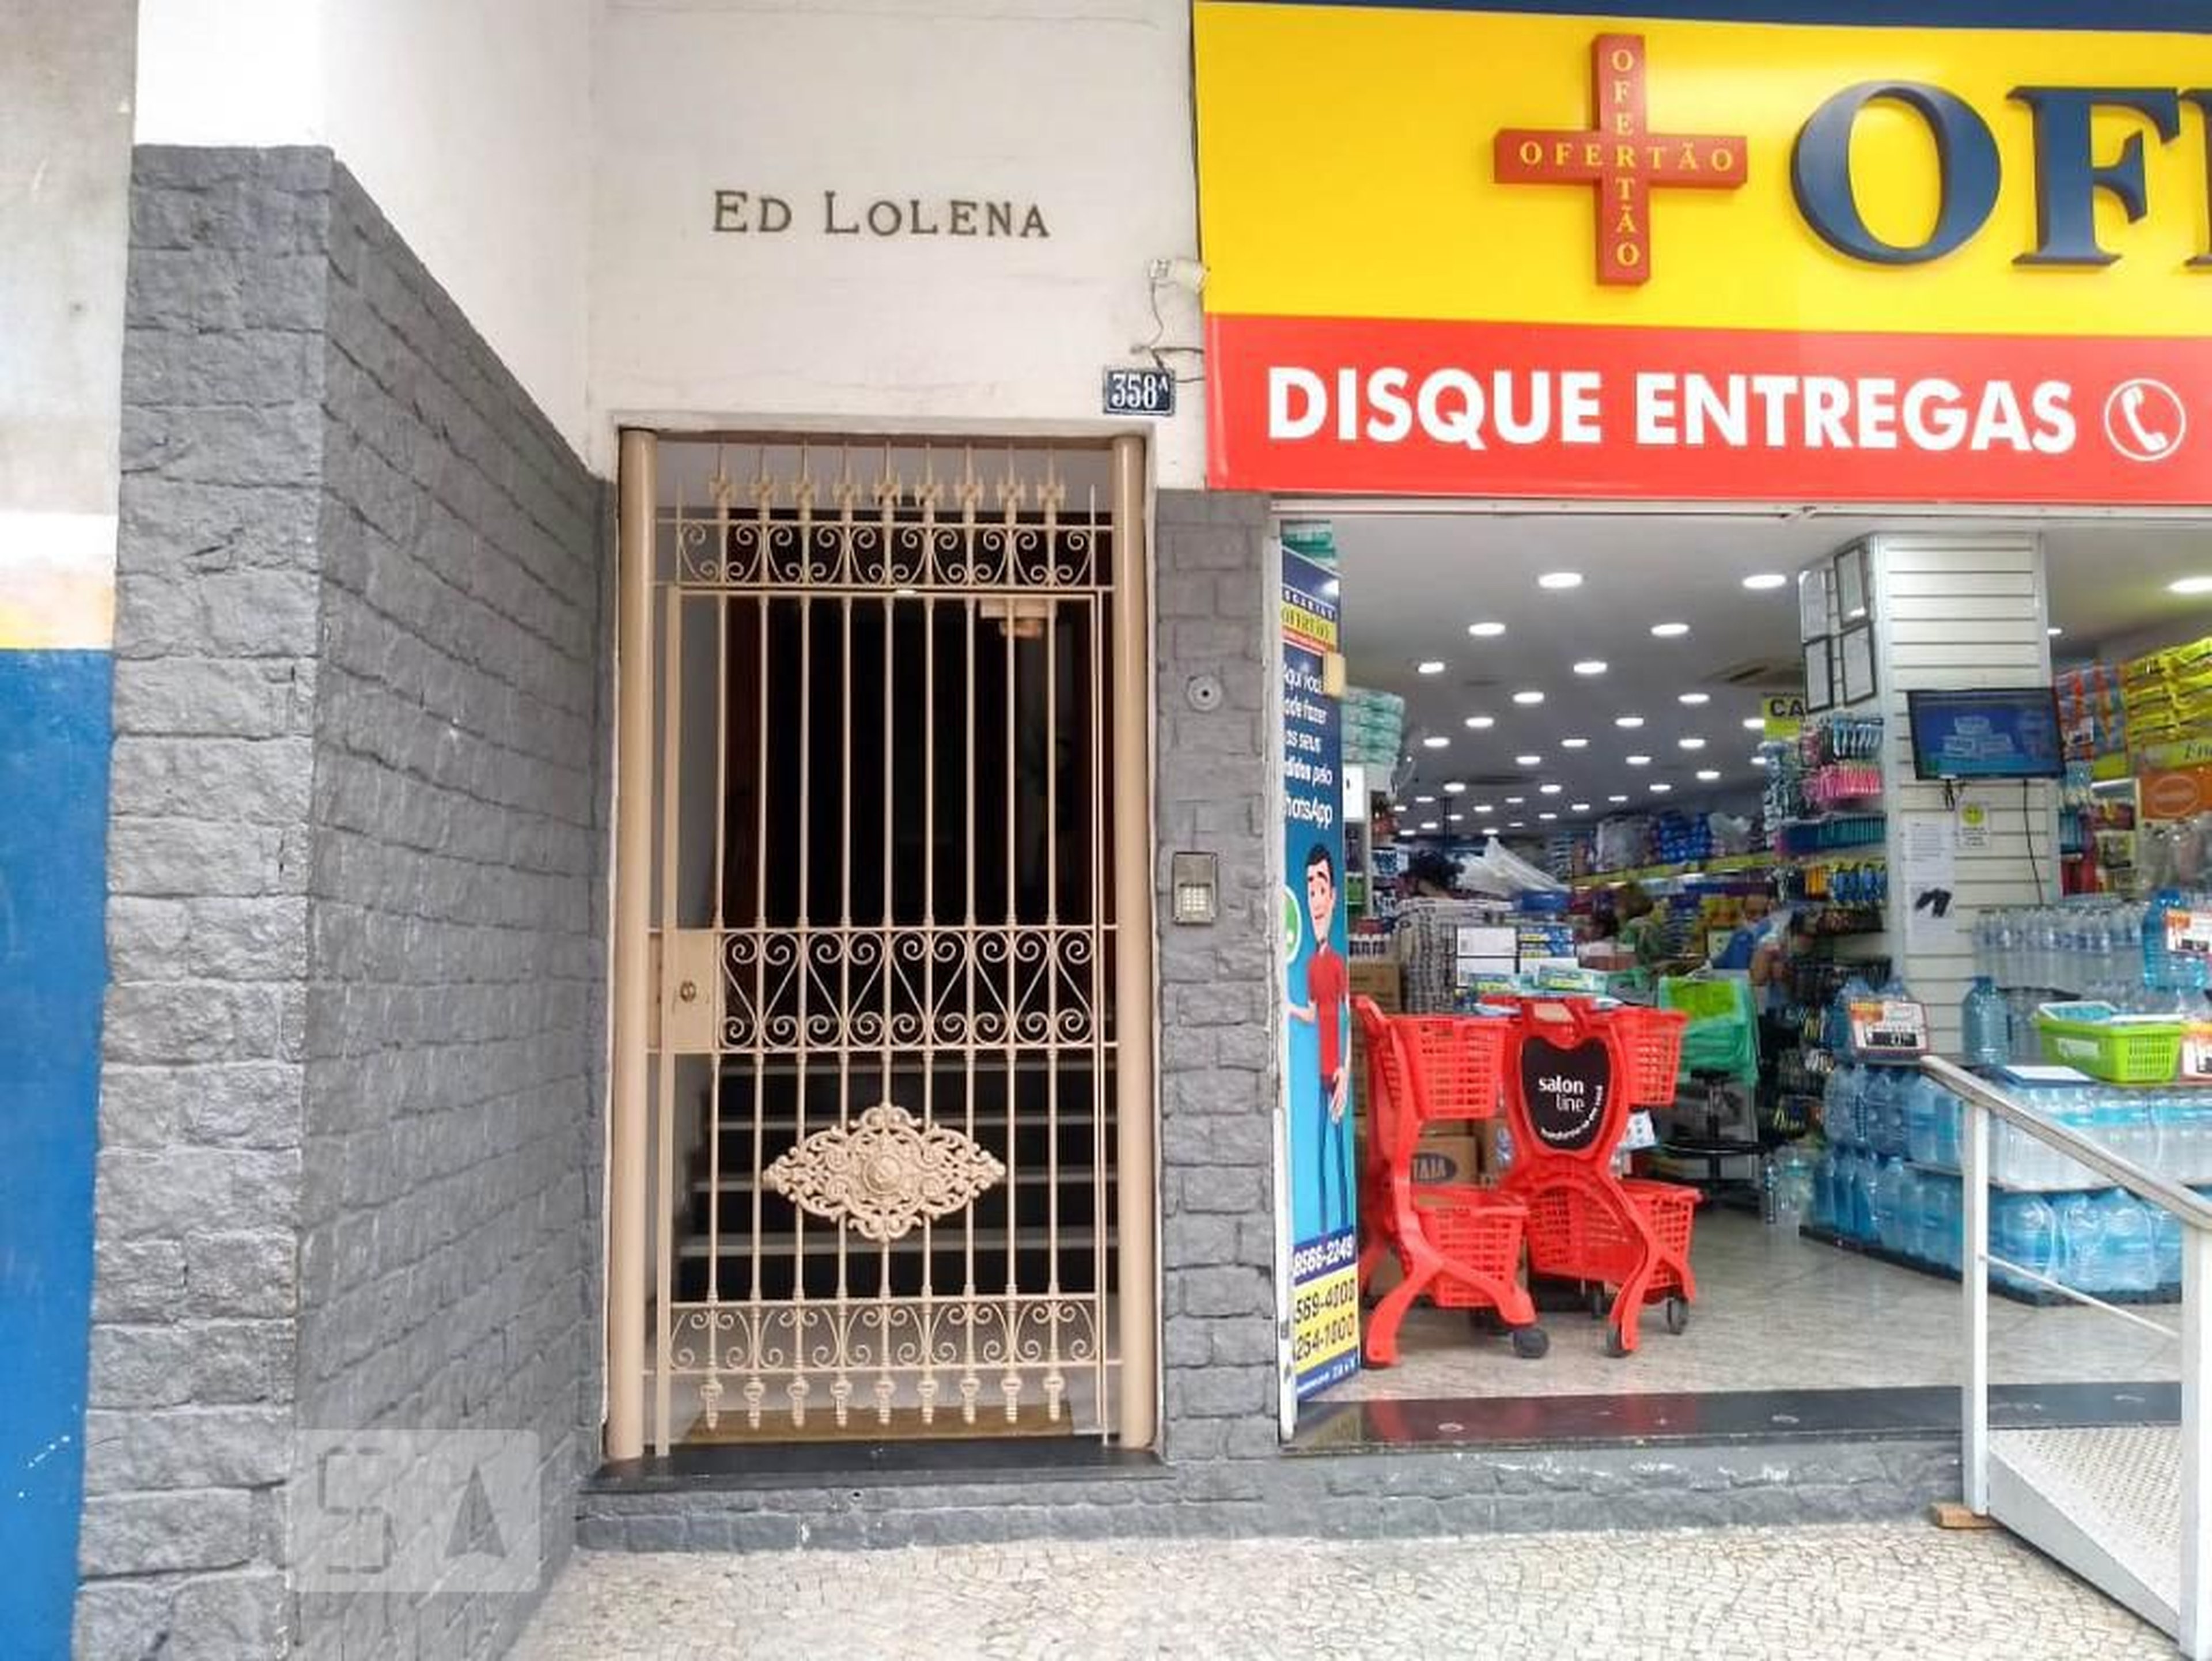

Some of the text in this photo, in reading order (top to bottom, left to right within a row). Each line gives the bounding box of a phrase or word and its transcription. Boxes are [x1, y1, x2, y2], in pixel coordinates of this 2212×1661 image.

[1519, 140, 1733, 173] OFERTÃO
[1790, 78, 2212, 268] OF
[824, 190, 1051, 237] LOLENA
[1268, 366, 2077, 454] DISQUE ENTREGAS
[1283, 695, 1302, 718] ode
[1538, 1074, 1584, 1095] salon
[1556, 1093, 1585, 1113] line
